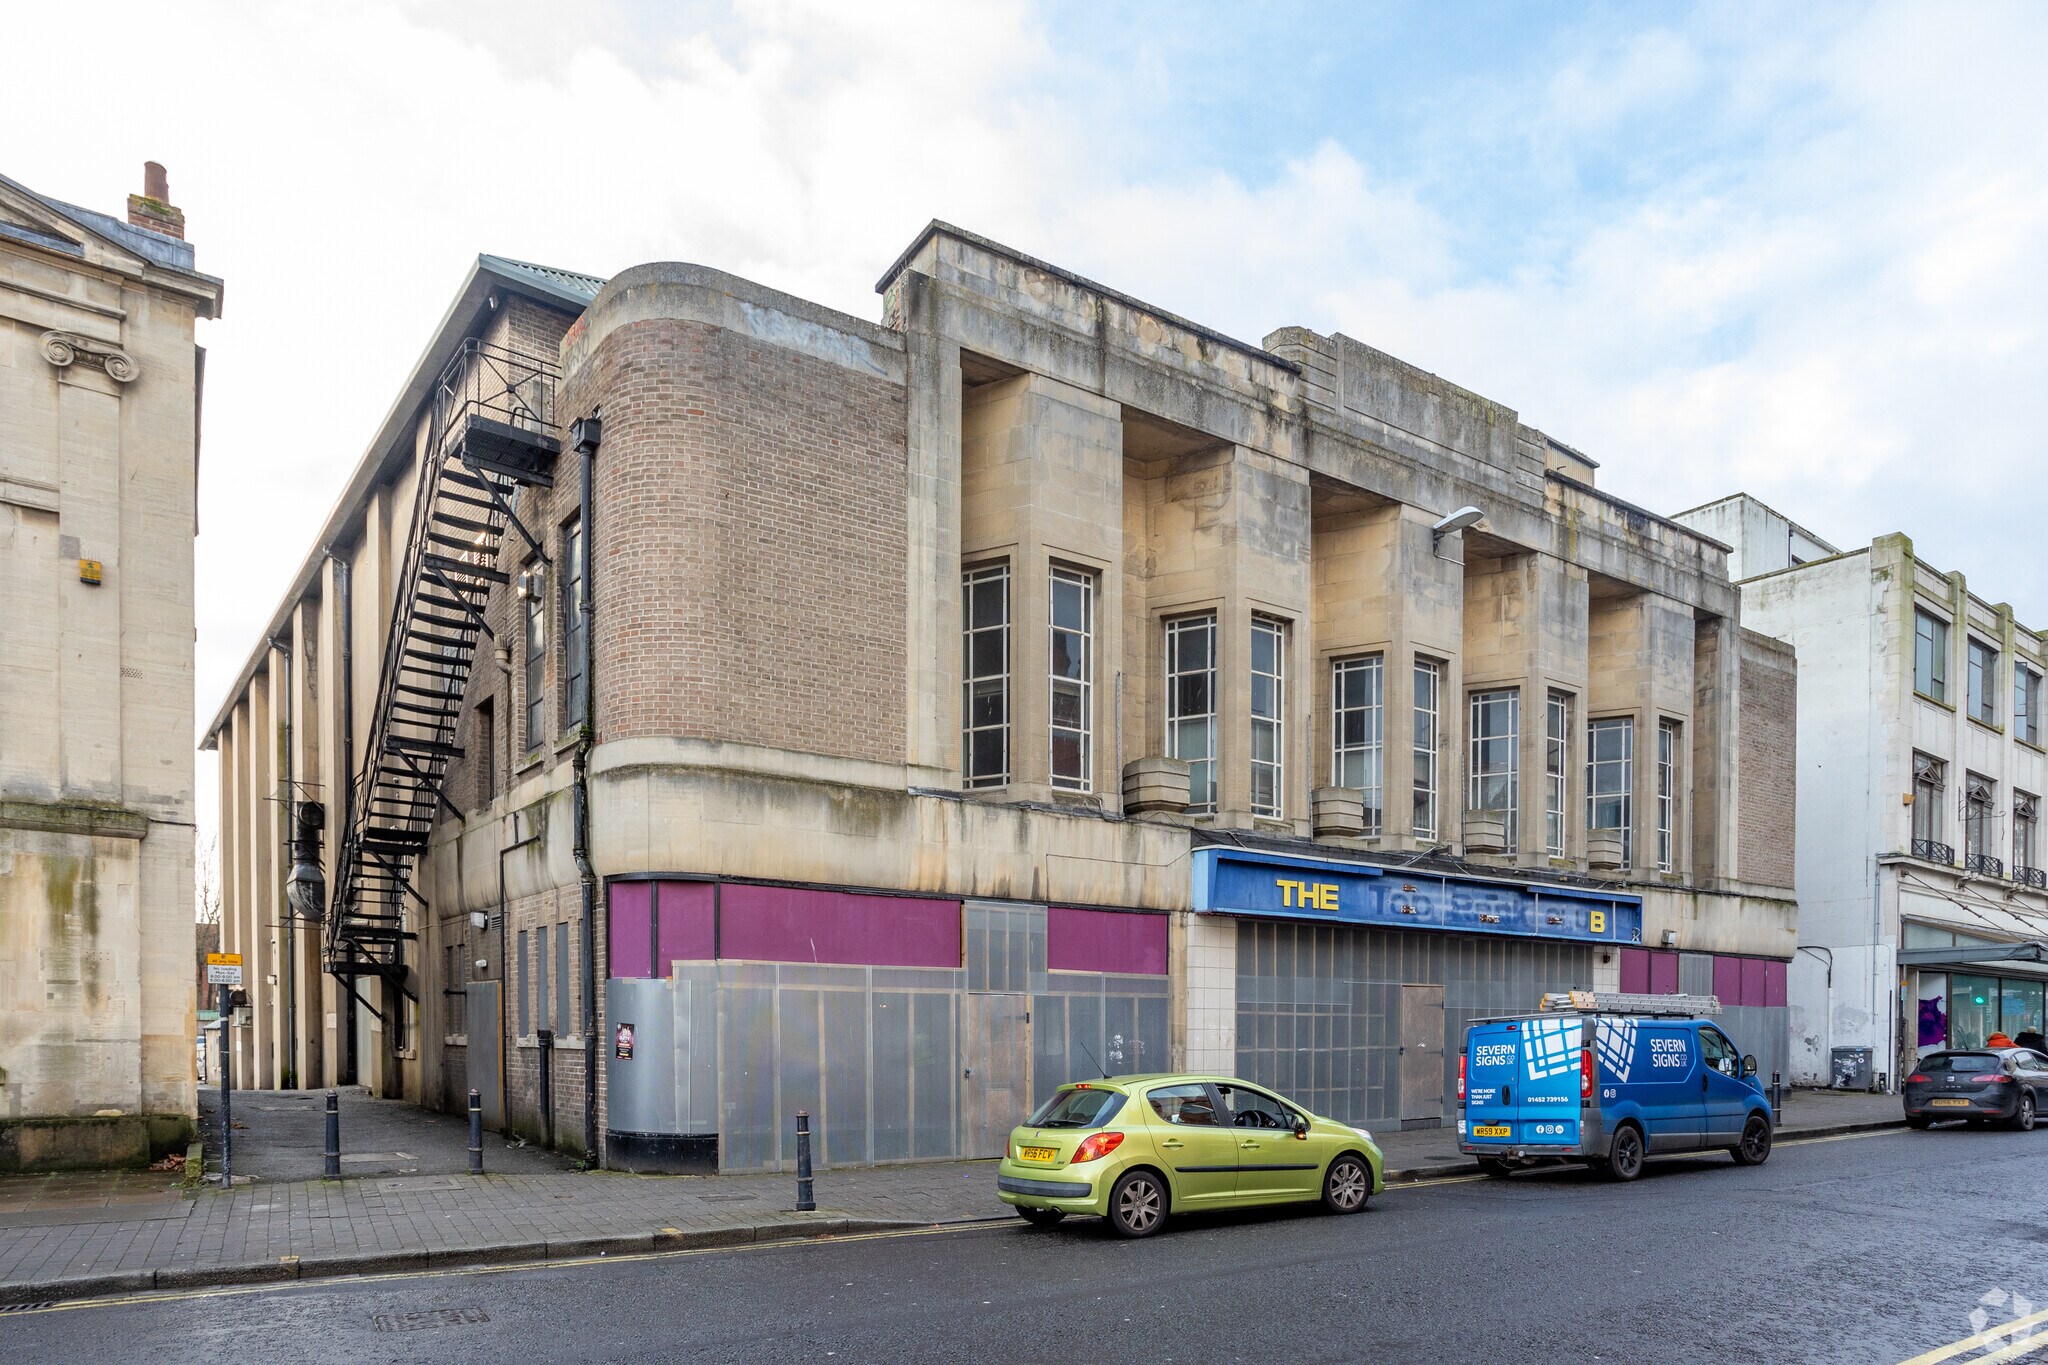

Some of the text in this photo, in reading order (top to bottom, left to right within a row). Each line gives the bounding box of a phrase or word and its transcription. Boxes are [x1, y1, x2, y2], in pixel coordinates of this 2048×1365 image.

[1276, 879, 1339, 911] THE
[1476, 1044, 1516, 1056] SEVERN
[1650, 1039, 1687, 1053] SEVERN
[1475, 1055, 1506, 1066] SIGNS
[1652, 1053, 1680, 1067] SIGNS
[1476, 1127, 1508, 1136] WR59 XXP
